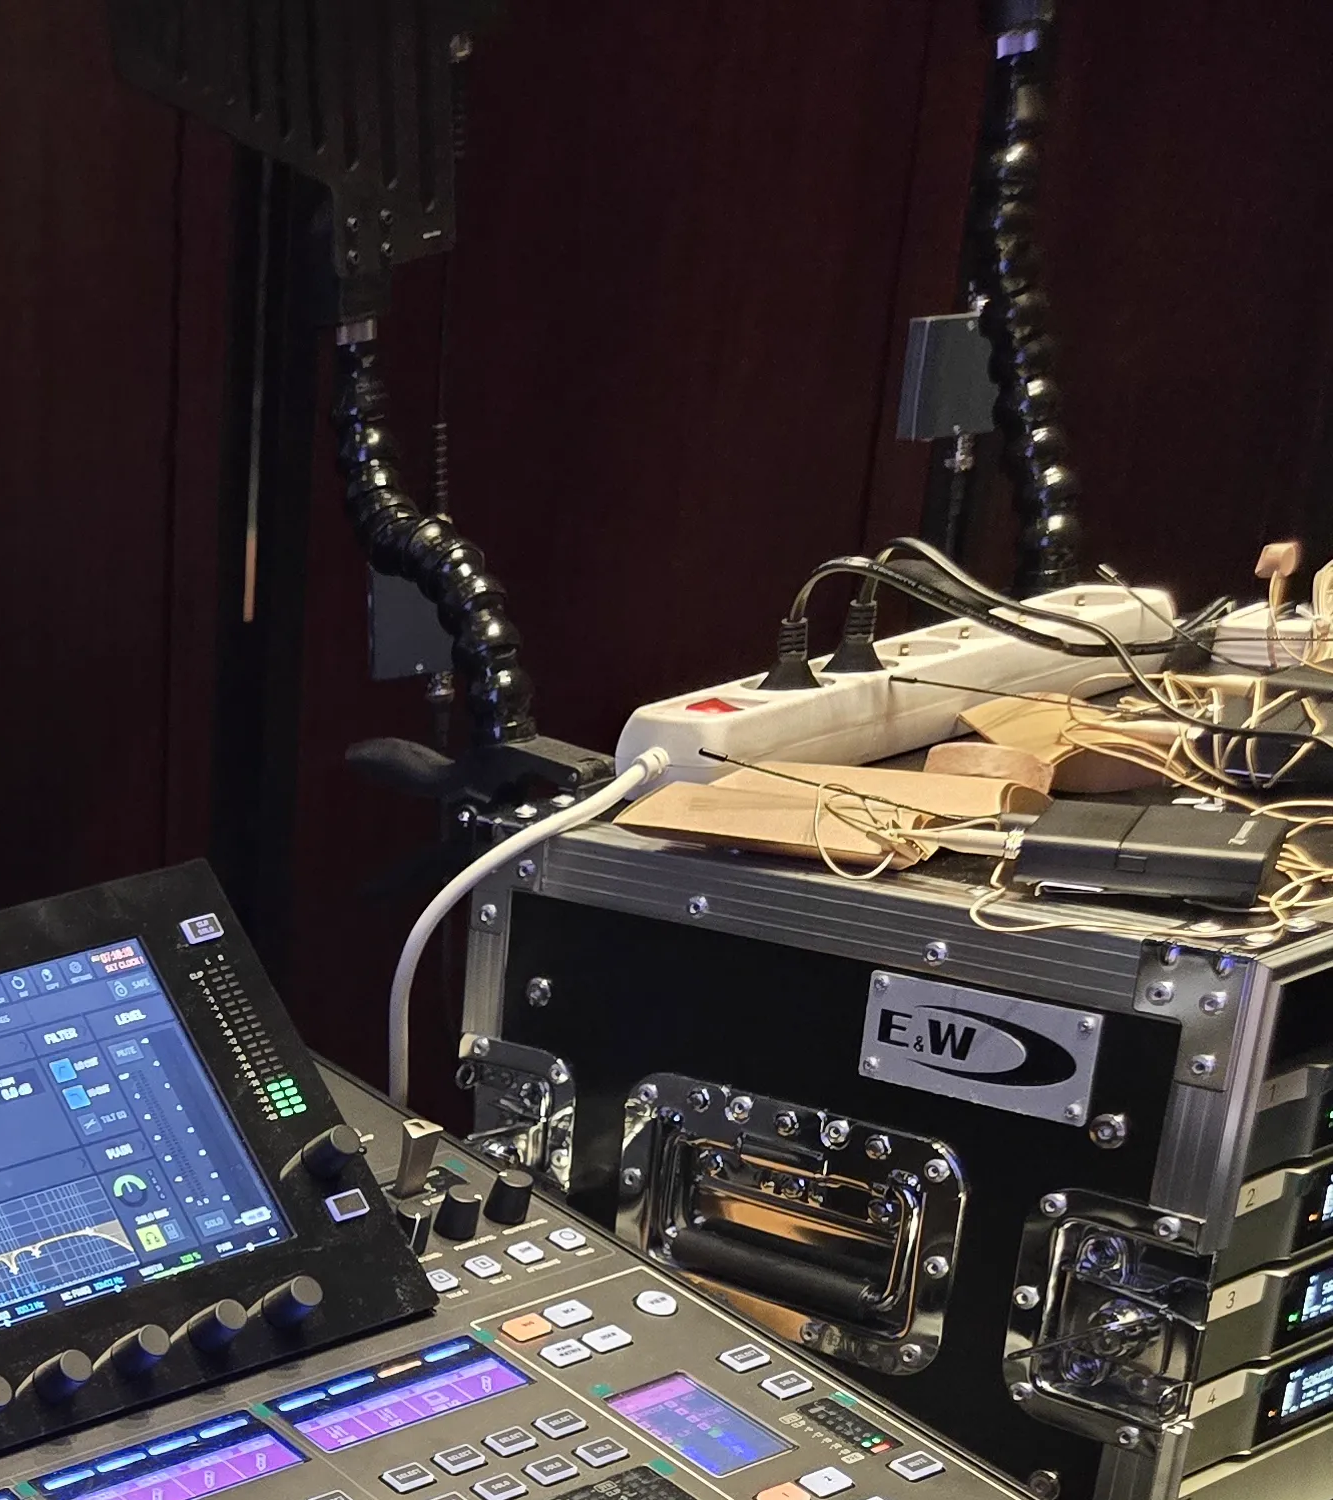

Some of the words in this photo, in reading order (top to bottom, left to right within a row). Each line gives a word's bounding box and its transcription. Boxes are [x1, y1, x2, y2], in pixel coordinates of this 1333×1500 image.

[105, 962, 118, 973] SET
[132, 978, 150, 989] SAFE
[114, 1009, 147, 1026] LEVEL
[43, 1027, 78, 1045] FILTER
[877, 1008, 977, 1061] E&W
[116, 1046, 137, 1058] MUTE
[101, 1113, 116, 1124] TILT
[106, 1143, 133, 1160] MAIN
[1245, 1188, 1256, 1208] 2
[205, 1216, 224, 1228] SOLO
[1226, 1290, 1236, 1309] 3
[1207, 1389, 1217, 1405] 4
[549, 1415, 574, 1426] SELECT
[499, 1432, 524, 1444] SELECT
[593, 1444, 613, 1454] SOLO
[447, 1450, 473, 1462] SELECT
[543, 1462, 562, 1472] SOLO
[396, 1468, 421, 1480] SELECT
[491, 1481, 511, 1491] SOLO
